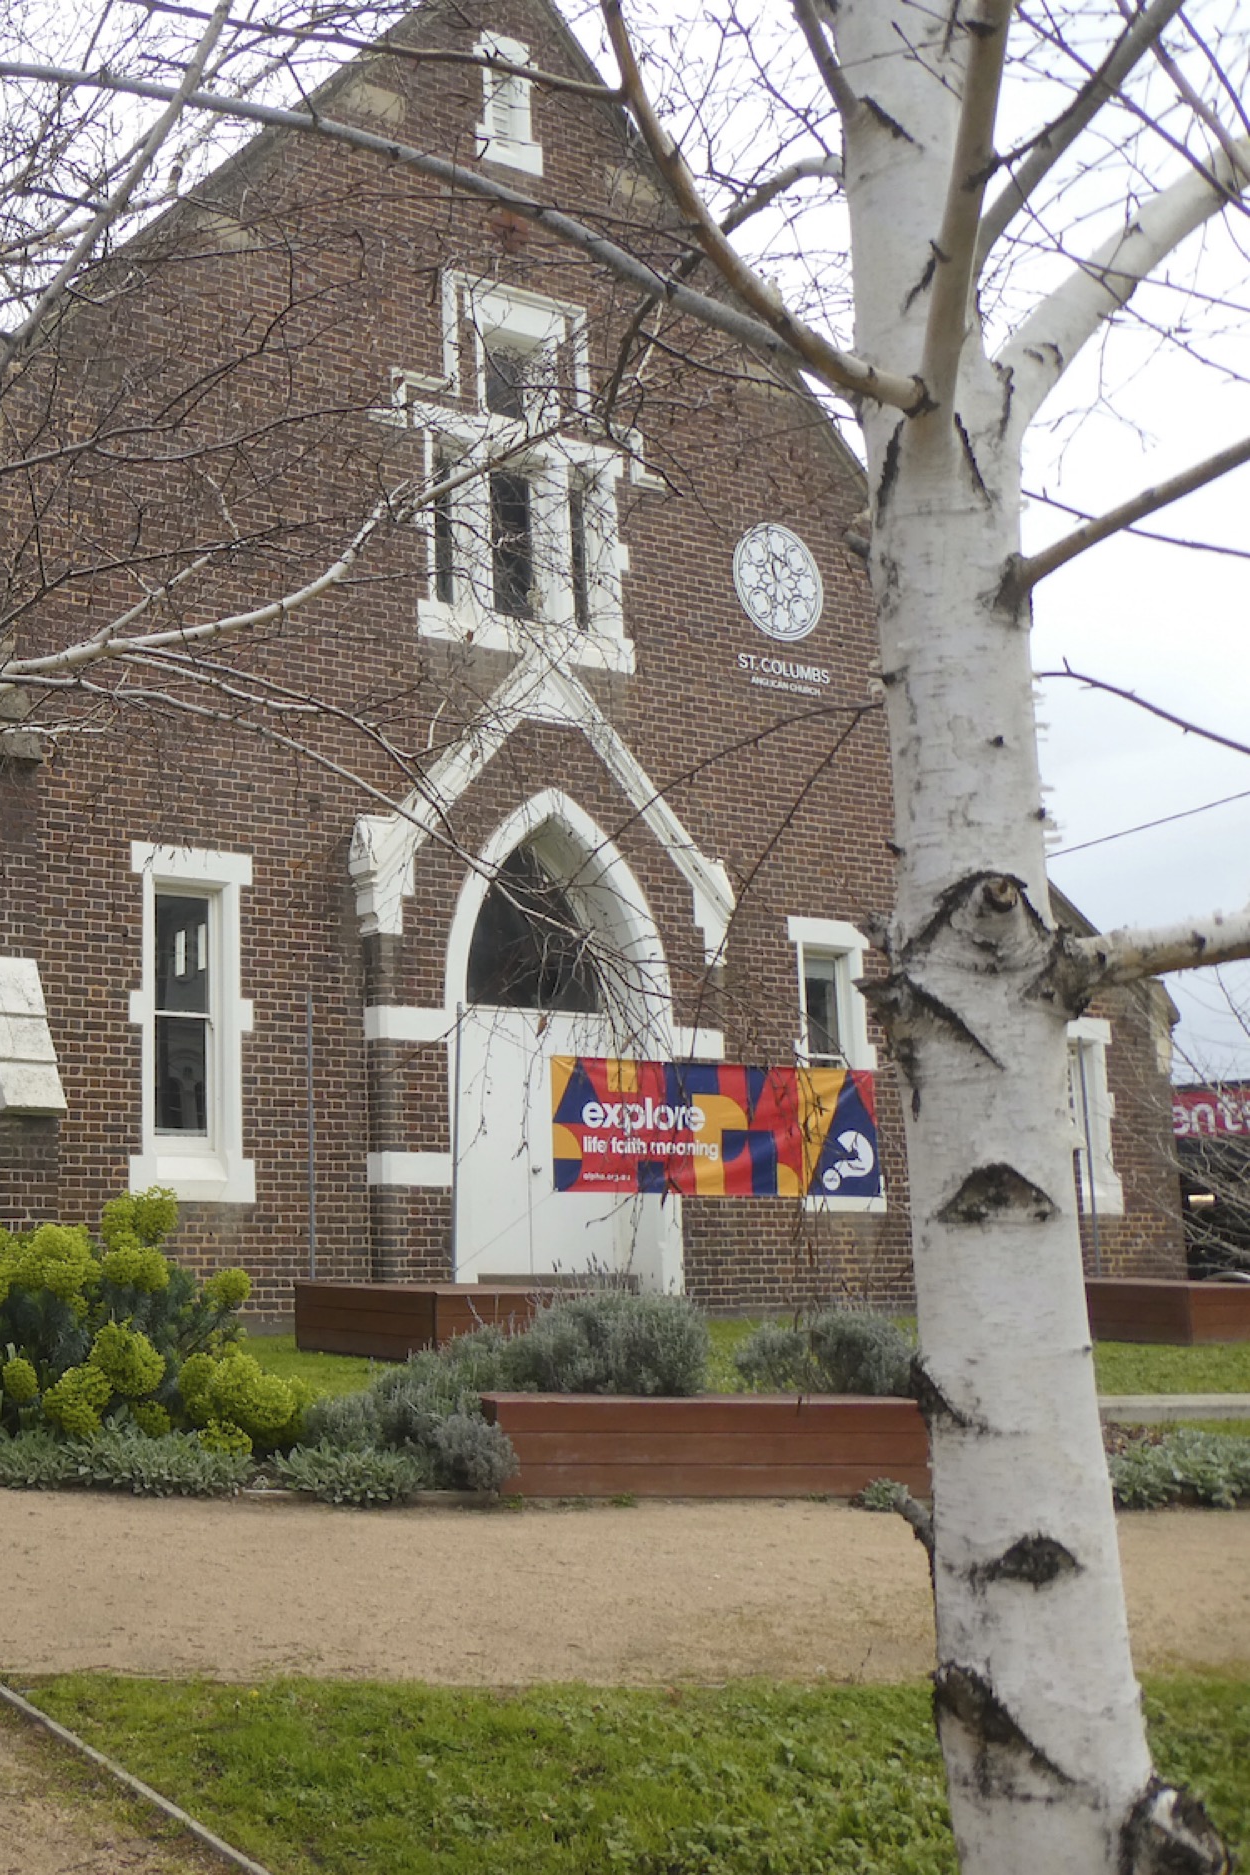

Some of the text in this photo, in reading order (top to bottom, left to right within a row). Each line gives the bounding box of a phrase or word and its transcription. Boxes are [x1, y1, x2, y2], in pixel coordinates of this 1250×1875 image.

[737, 653, 831, 684] ST. COLUMBS
[751, 676, 821, 697] ANGLICAN CHURCH
[581, 1097, 706, 1136] explore
[582, 1135, 719, 1161] life faith meaning
